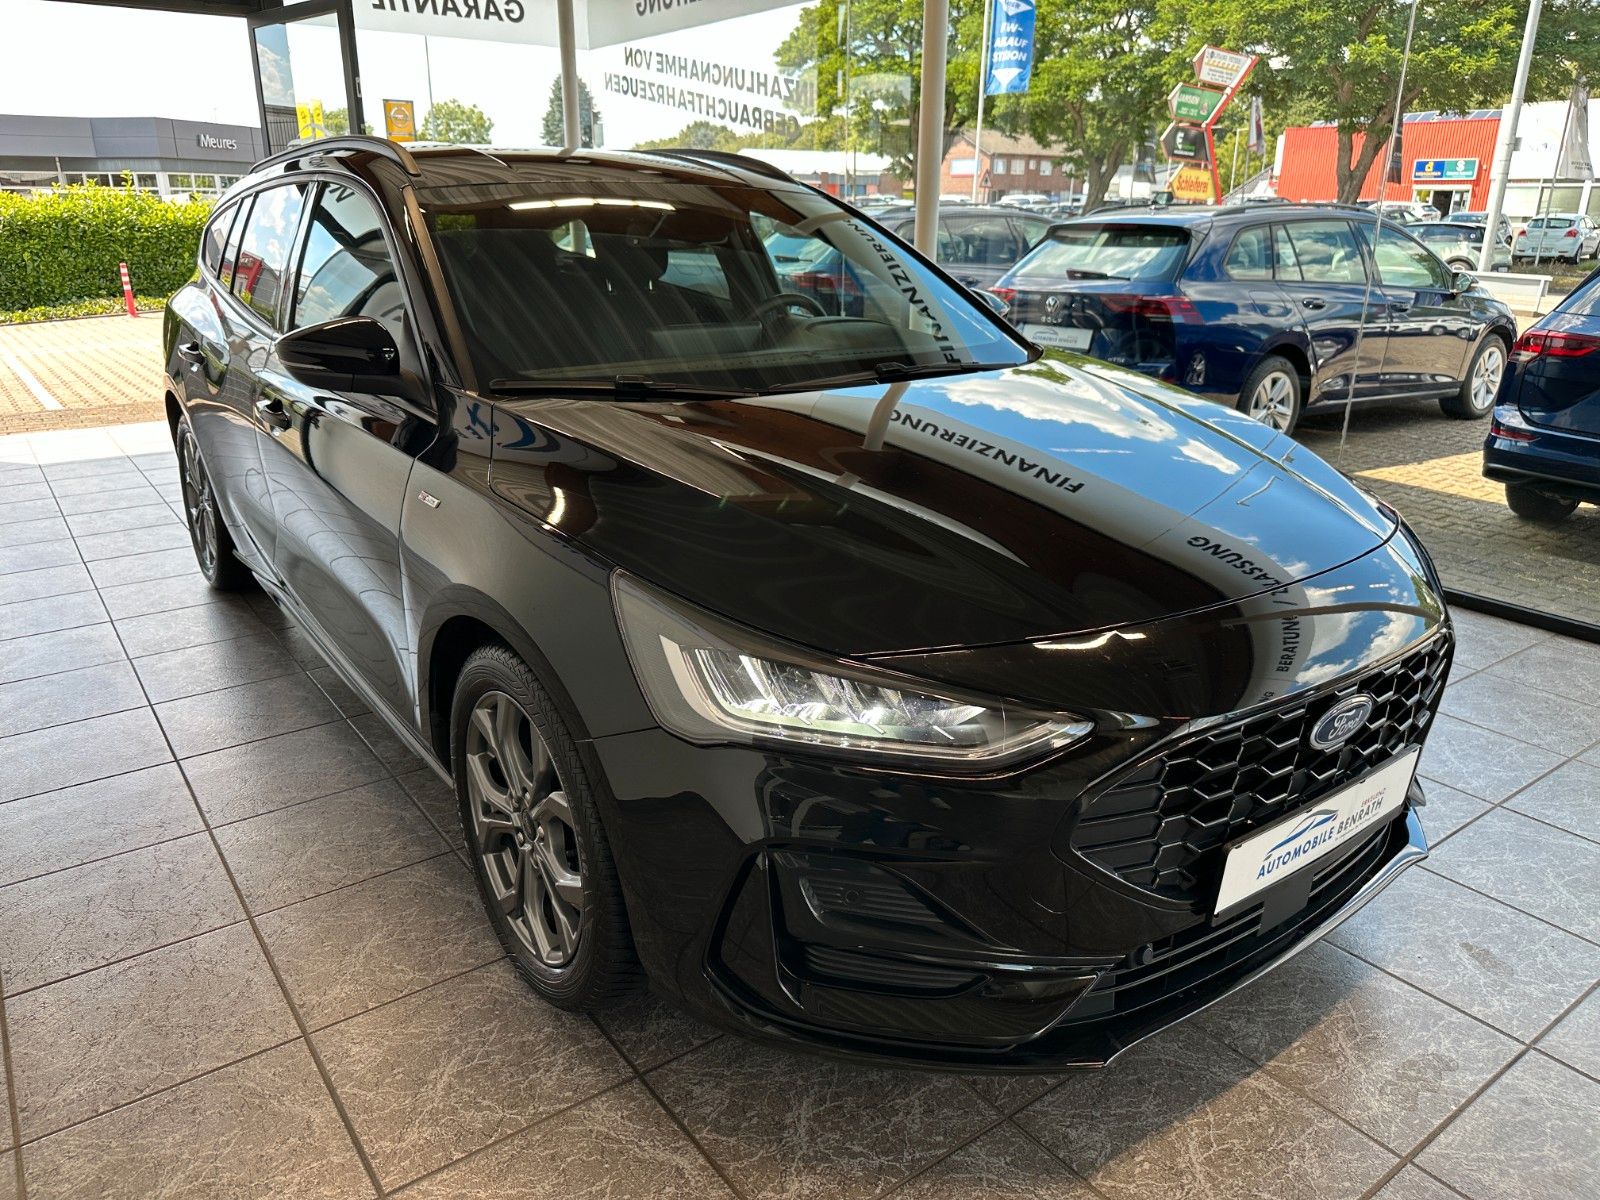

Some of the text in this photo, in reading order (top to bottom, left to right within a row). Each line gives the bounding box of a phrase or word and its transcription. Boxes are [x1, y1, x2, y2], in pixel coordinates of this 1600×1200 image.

[200, 133, 238, 150] Meures
[1176, 174, 1209, 193] Schleiferei
[843, 219, 961, 365] FINANZIERUN
[1041, 316, 1062, 324] GOLF
[1276, 615, 1300, 672] BERATUN
[1256, 826, 1335, 880] AUTOMOBILE
[1337, 797, 1384, 835] BENRATH
